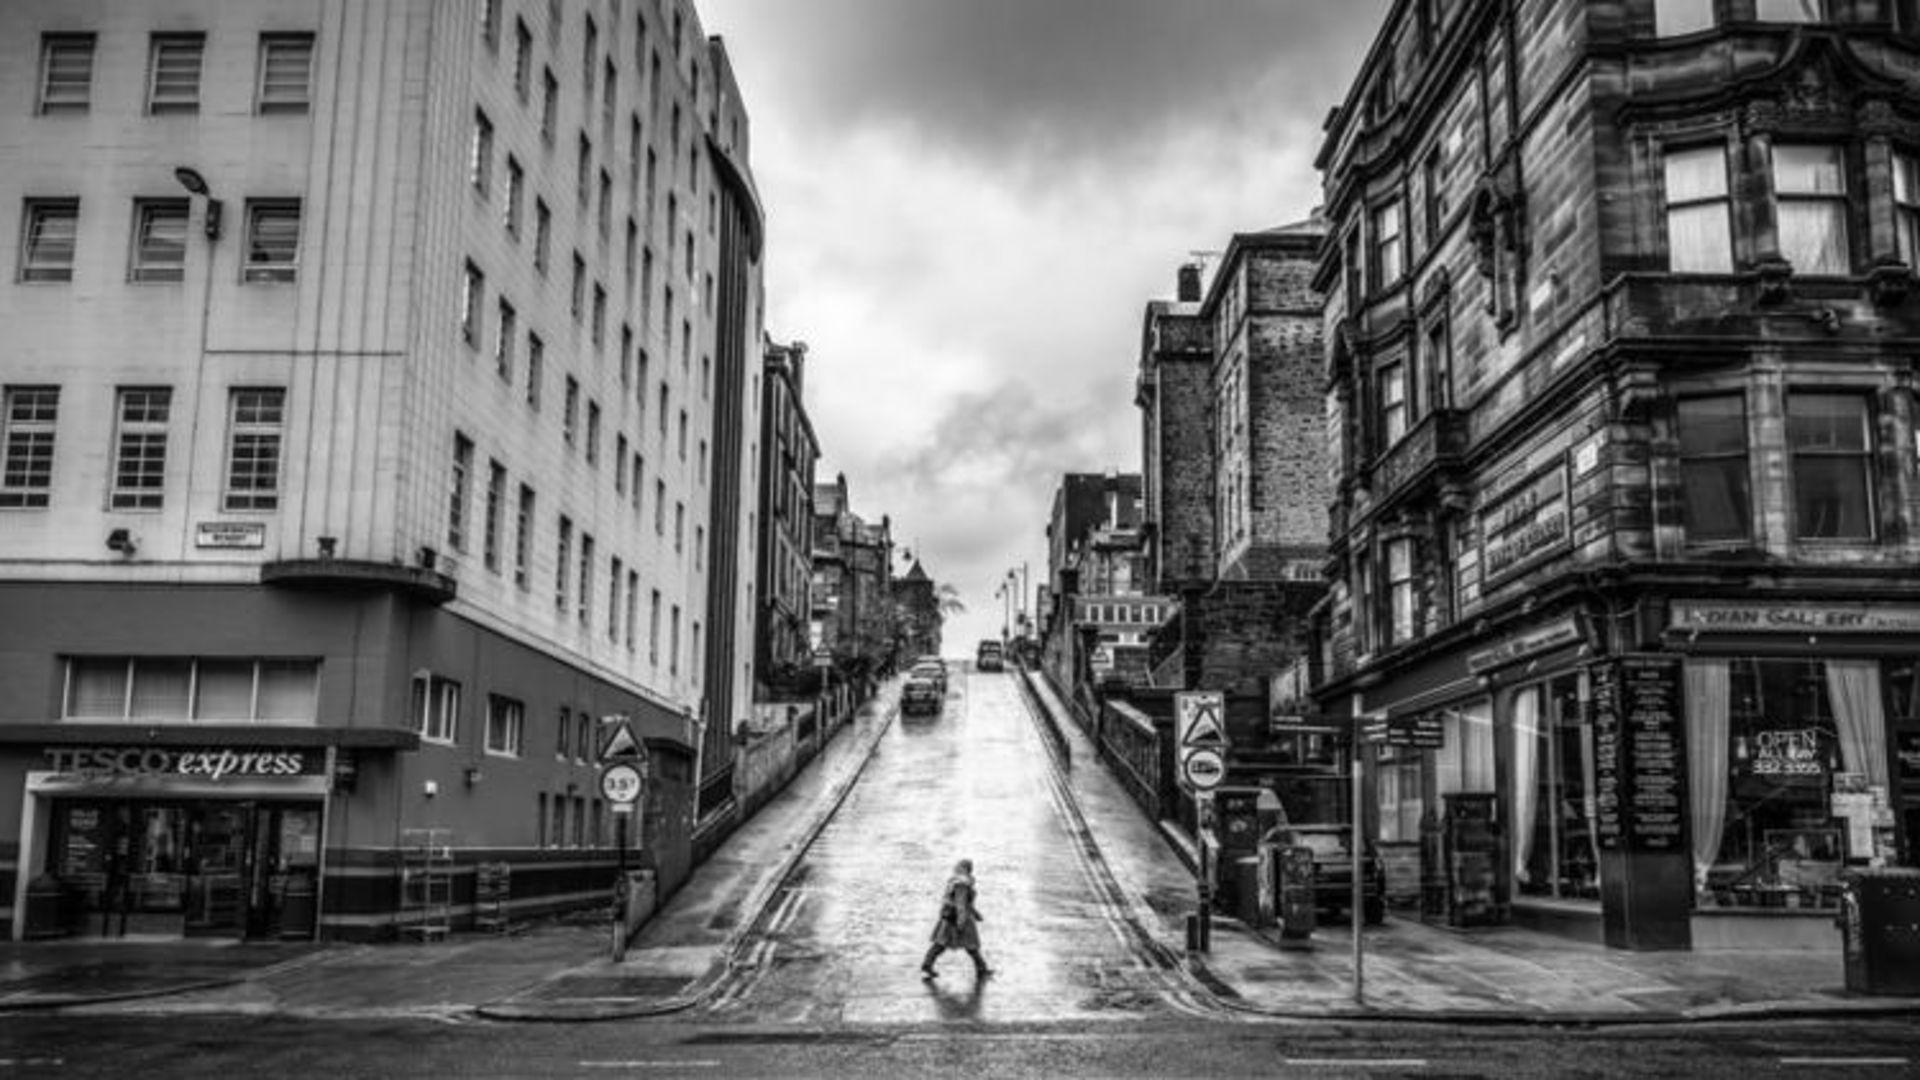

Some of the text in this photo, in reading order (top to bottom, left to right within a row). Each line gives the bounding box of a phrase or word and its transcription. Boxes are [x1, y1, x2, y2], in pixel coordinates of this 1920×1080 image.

[1684, 607, 1758, 622] IDIAN
[1757, 730, 1816, 749] OPEN
[45, 750, 303, 779] TESCO express
